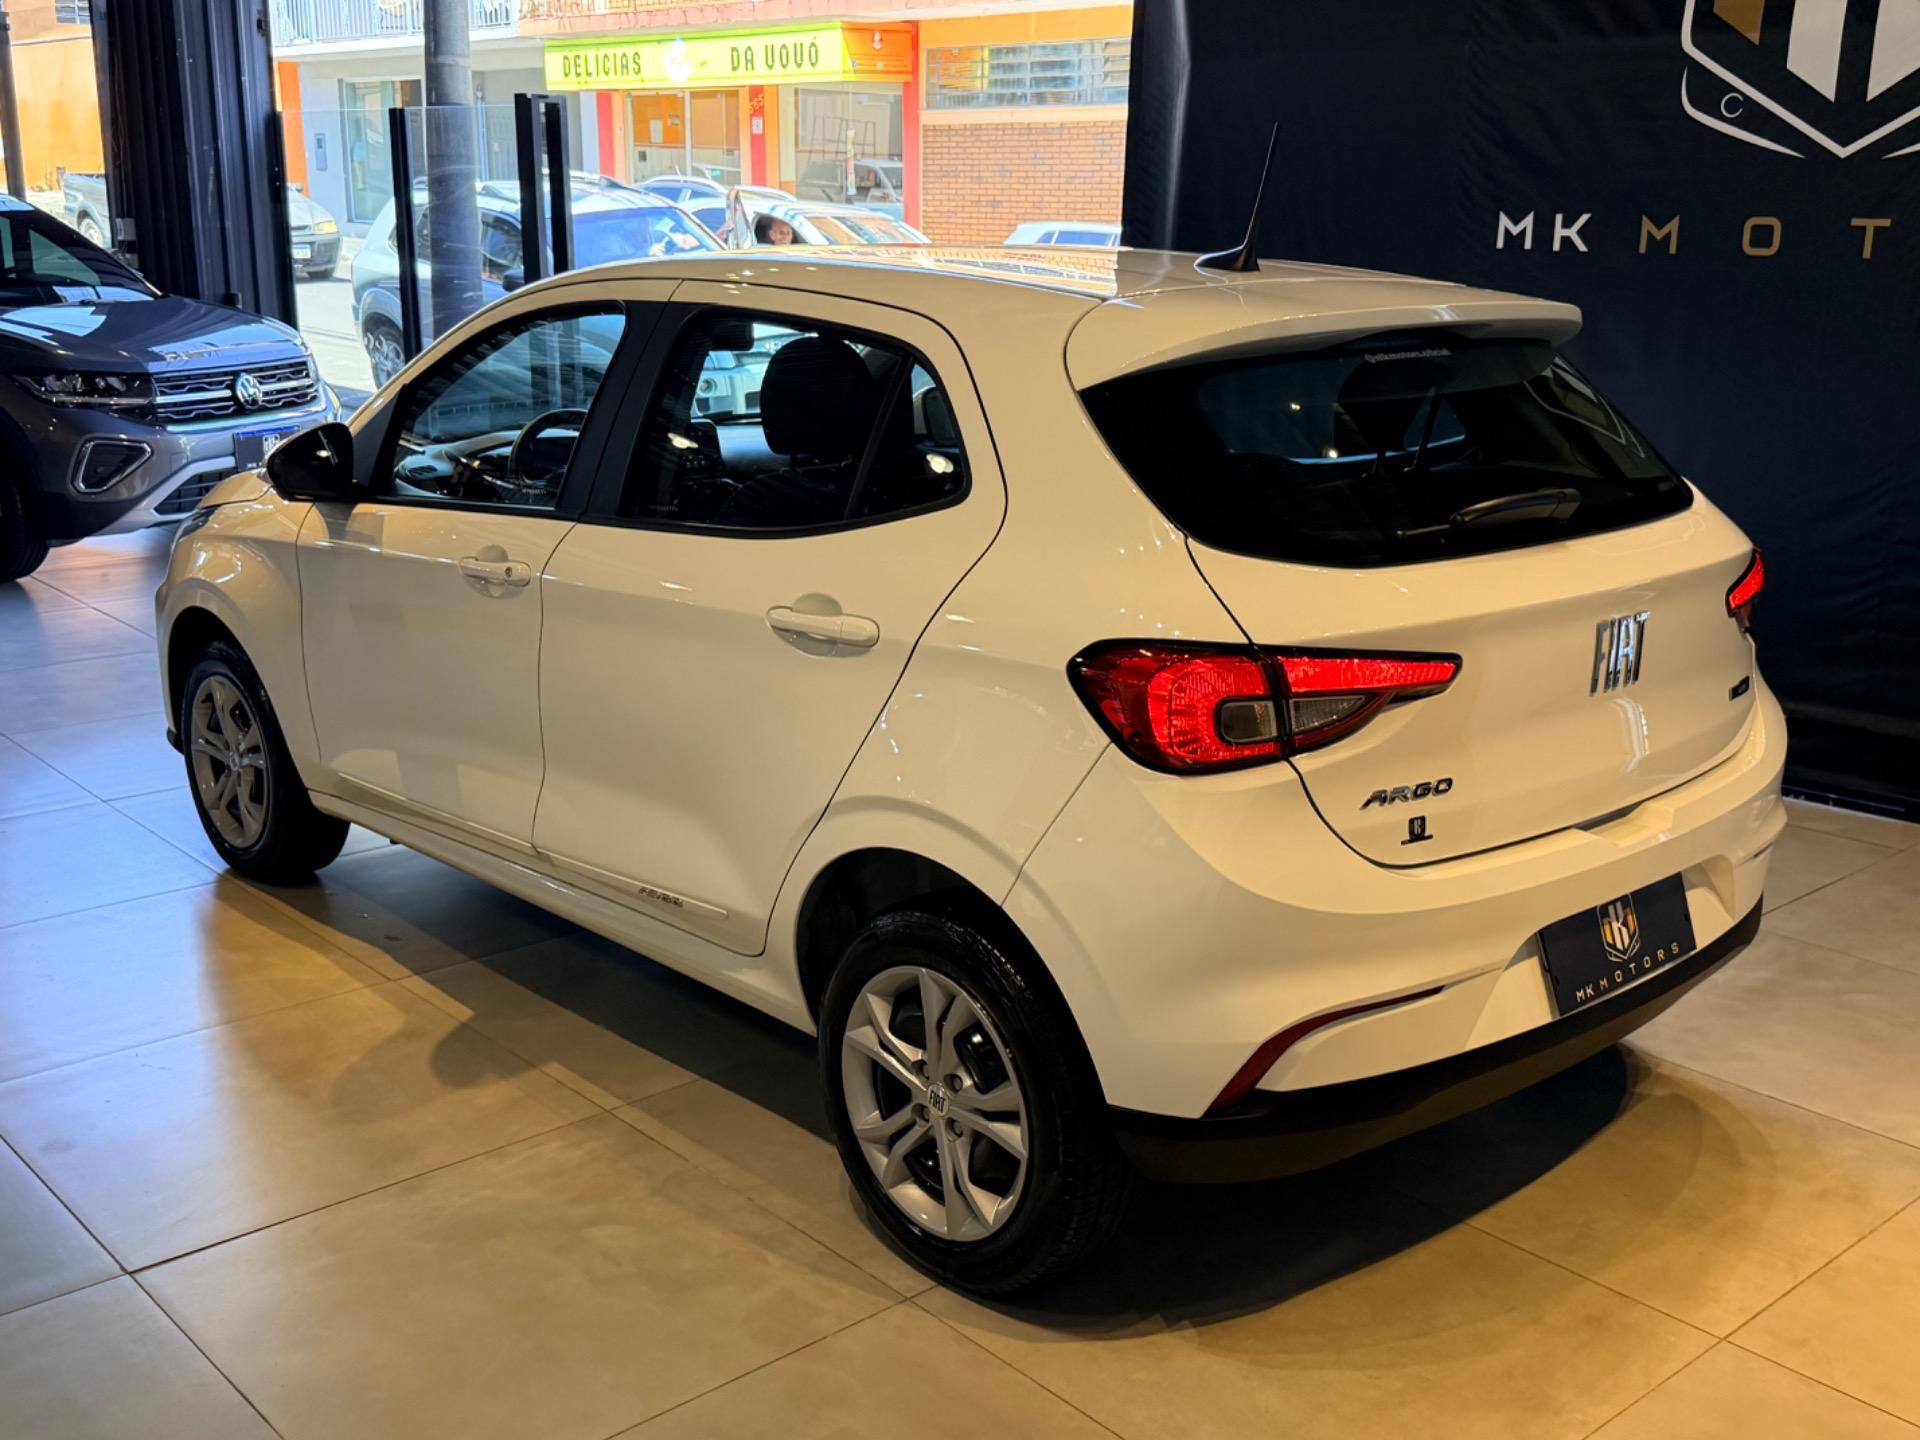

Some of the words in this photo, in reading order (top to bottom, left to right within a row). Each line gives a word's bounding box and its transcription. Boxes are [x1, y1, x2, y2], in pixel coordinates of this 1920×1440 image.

[731, 46, 755, 72] DA
[1496, 210, 1592, 253] MK
[1638, 214, 1892, 260] MOT
[1589, 609, 1650, 697] FIAT
[1359, 777, 1454, 811] ARGO
[1575, 983, 1595, 1003] MK
[1599, 941, 1680, 992] MOTORS
[928, 1089, 945, 1113] FIAT
